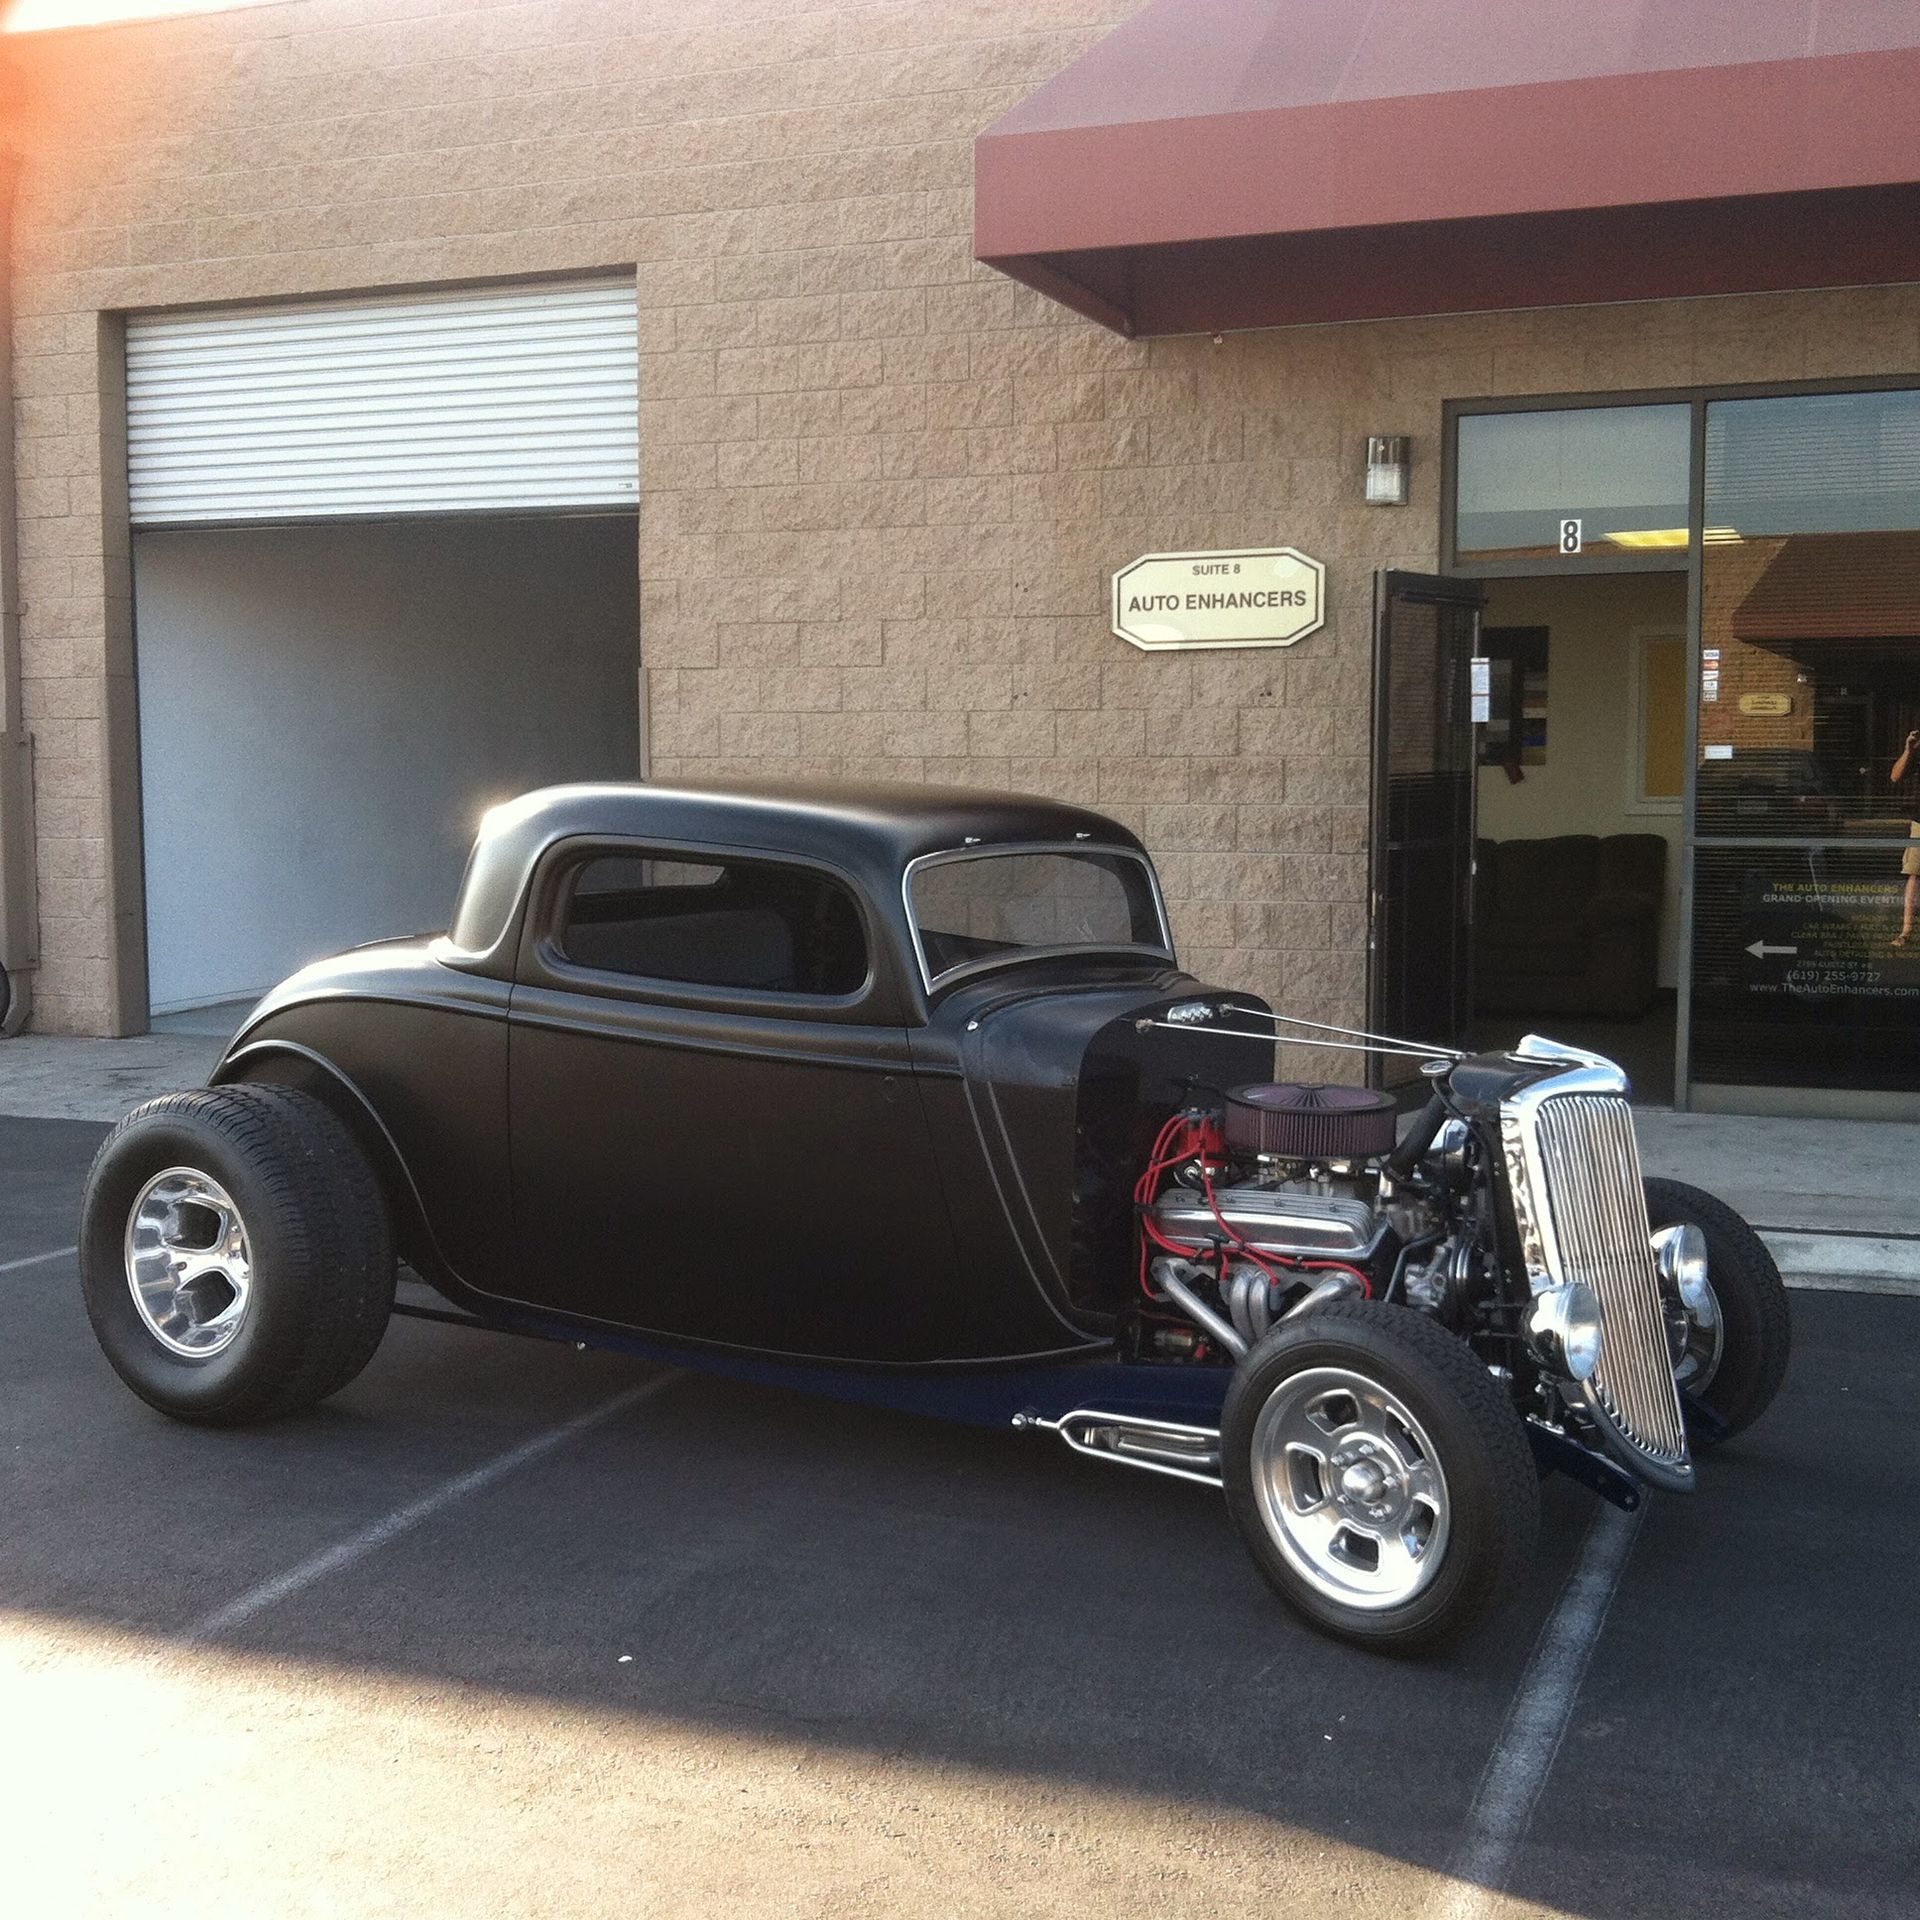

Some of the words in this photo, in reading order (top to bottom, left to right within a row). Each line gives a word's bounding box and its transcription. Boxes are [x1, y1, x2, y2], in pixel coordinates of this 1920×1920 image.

[1563, 521, 1578, 552] 8
[1192, 564, 1229, 576] SUITE
[1233, 563, 1241, 575] 8
[1128, 594, 1180, 612] AUTO
[1185, 590, 1307, 610] ENHANCERS
[1773, 883, 1794, 892] THE
[1797, 883, 1828, 892] AUTO
[1830, 883, 1899, 894] ENHANCERS
[1762, 894, 1802, 903] GRAND
[1805, 894, 1857, 904] OPENING
[1787, 970, 1819, 982] (619)
[1824, 970, 1881, 982] 255-9727
